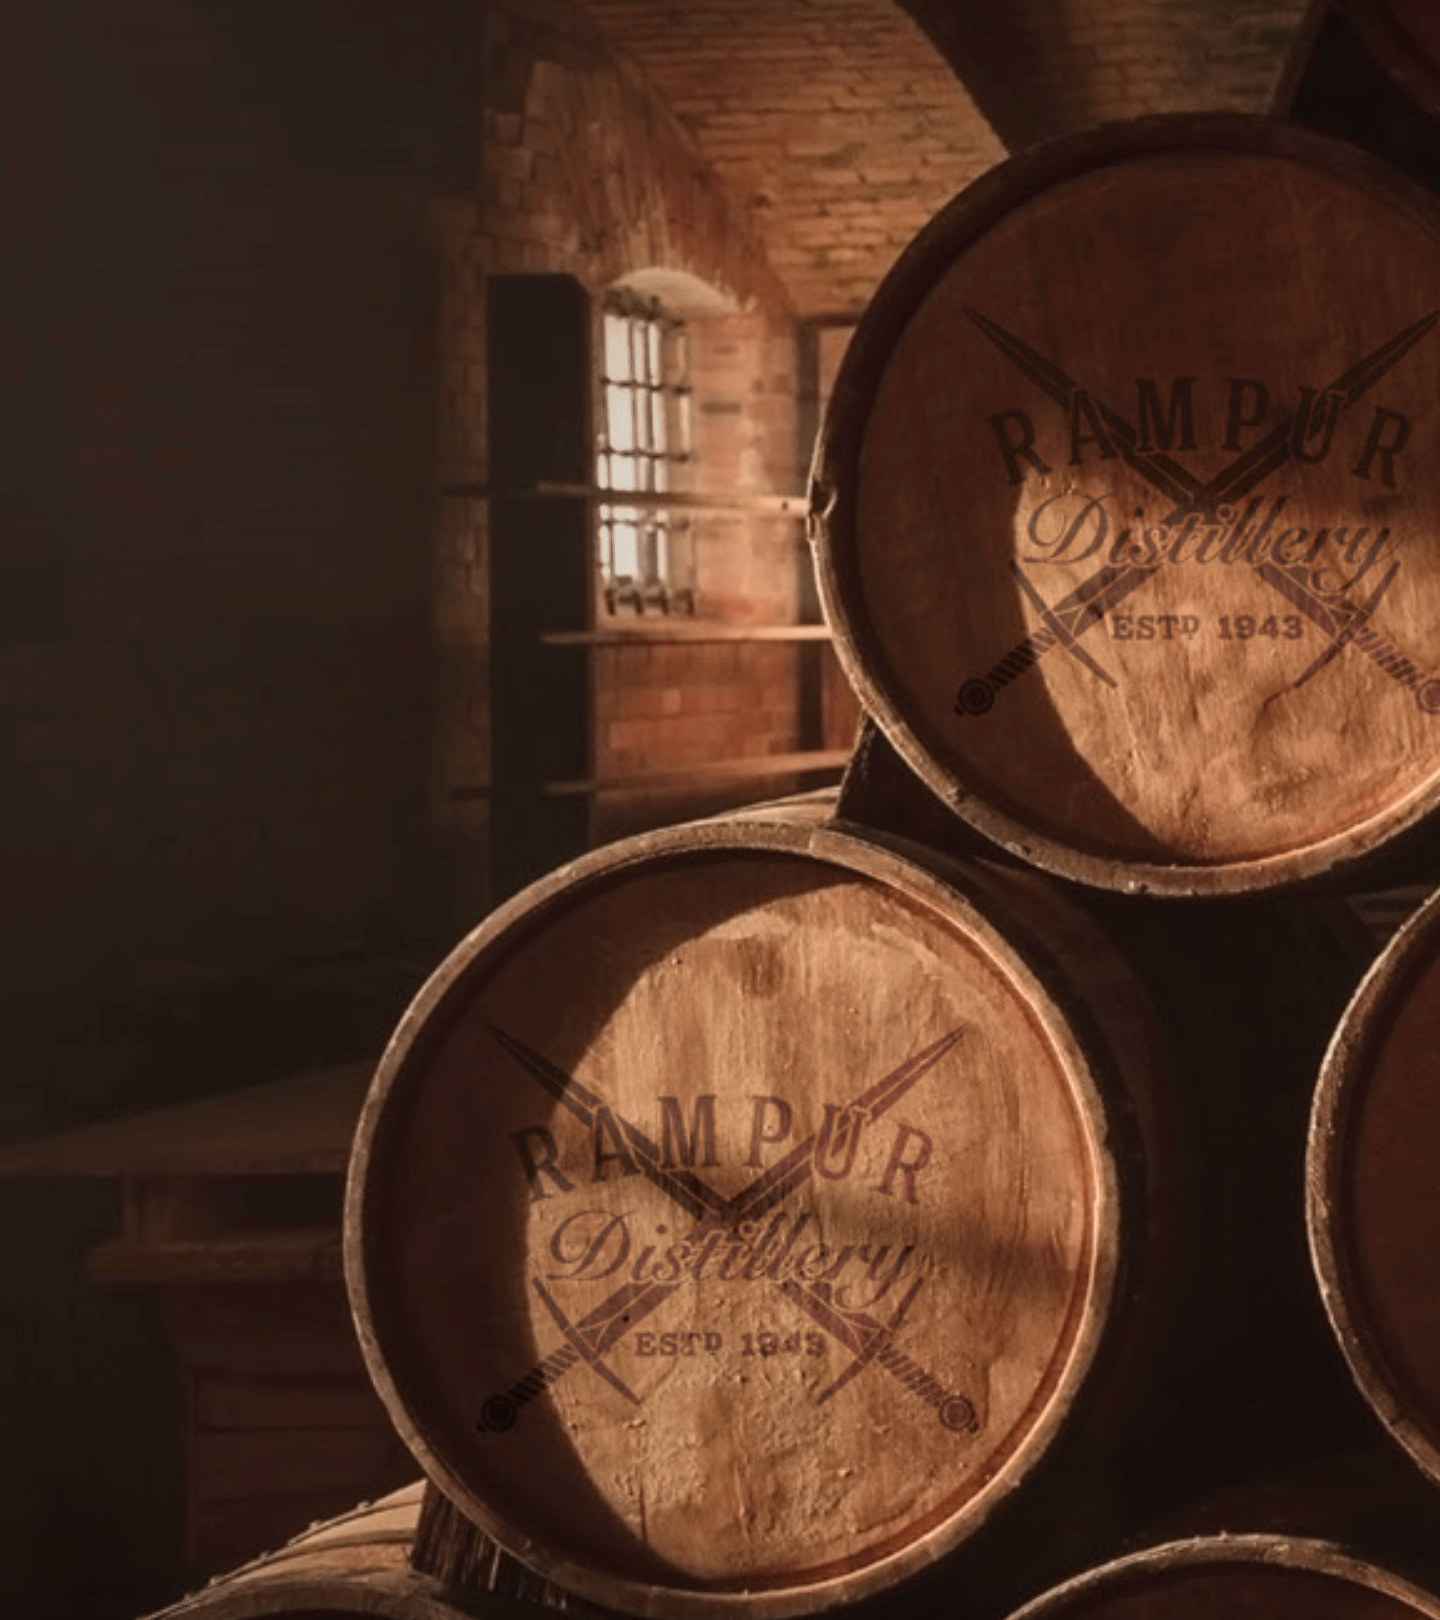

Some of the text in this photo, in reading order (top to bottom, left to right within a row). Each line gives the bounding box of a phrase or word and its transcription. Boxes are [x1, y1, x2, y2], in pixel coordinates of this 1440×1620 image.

[986, 376, 1412, 487] RAMPUR
[1022, 493, 1408, 595] Distillery
[1218, 615, 1305, 641] 1943
[509, 1093, 935, 1204] RAMPUR
[545, 1209, 930, 1311] Distillery
[741, 1332, 828, 1358] 1943
